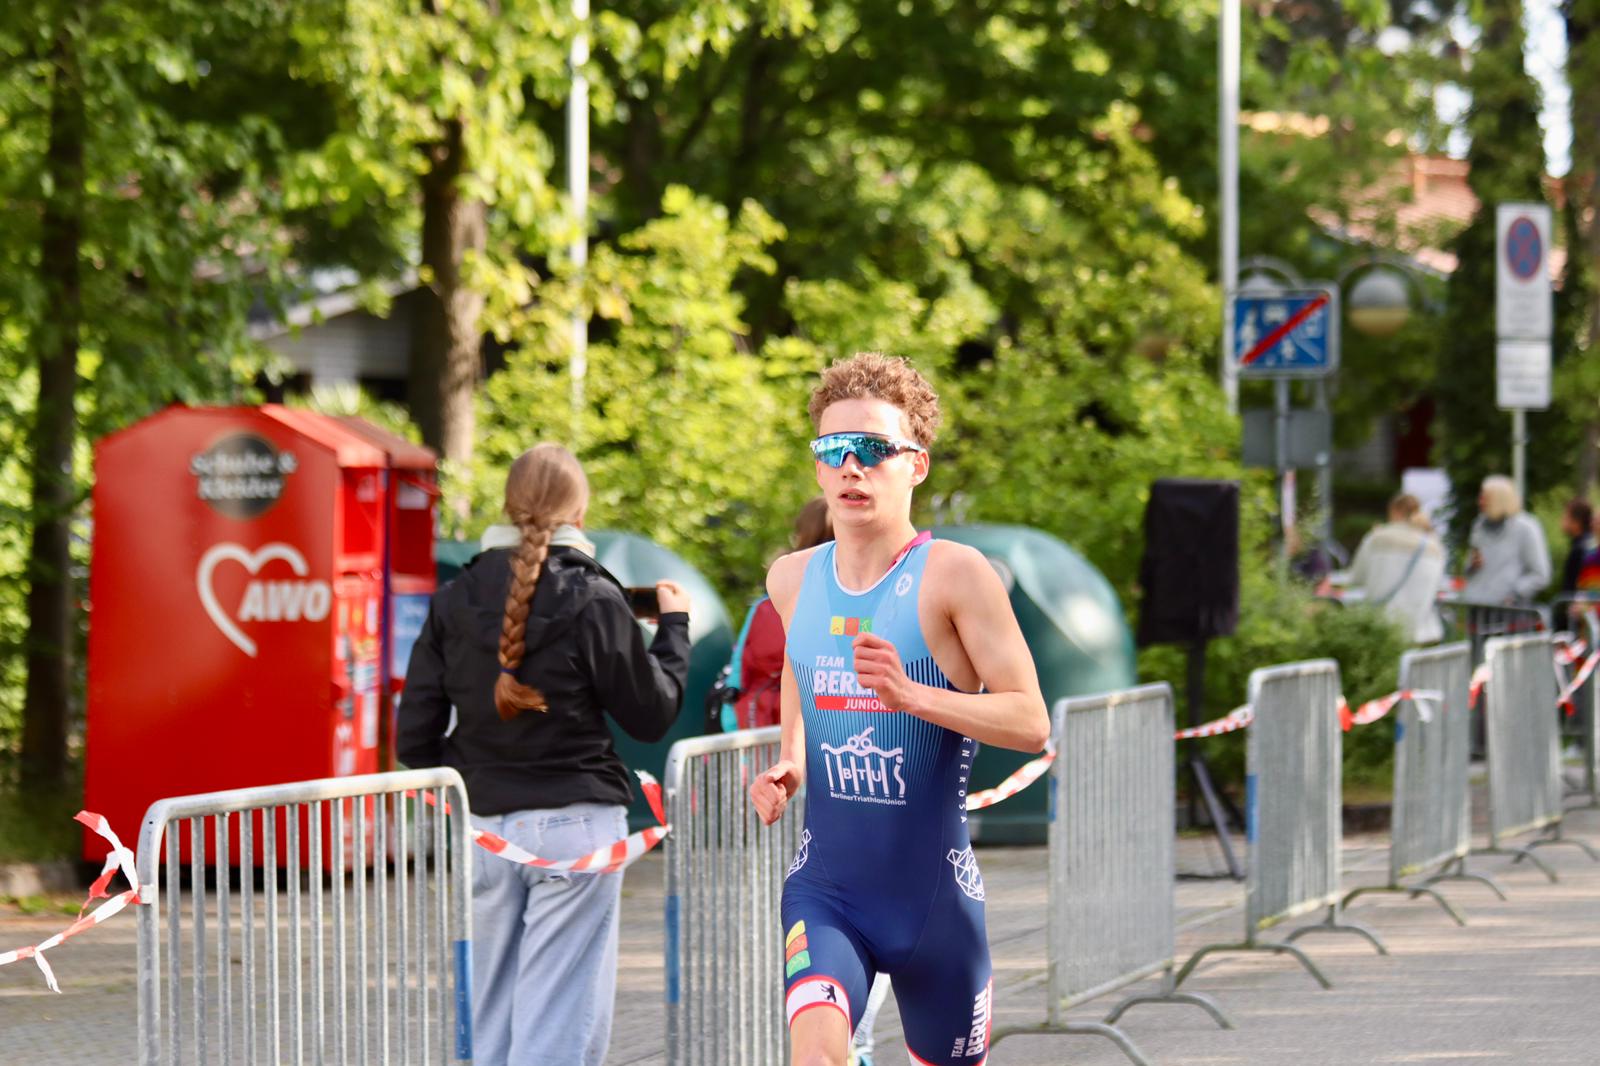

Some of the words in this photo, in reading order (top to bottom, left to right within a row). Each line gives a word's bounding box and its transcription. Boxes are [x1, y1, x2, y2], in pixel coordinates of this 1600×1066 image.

[240, 581, 331, 621] AWO
[815, 656, 845, 668] TEAM
[844, 698, 892, 711] JUNIOR
[965, 988, 987, 1057] BERLIN
[951, 1037, 966, 1058] TEAM
